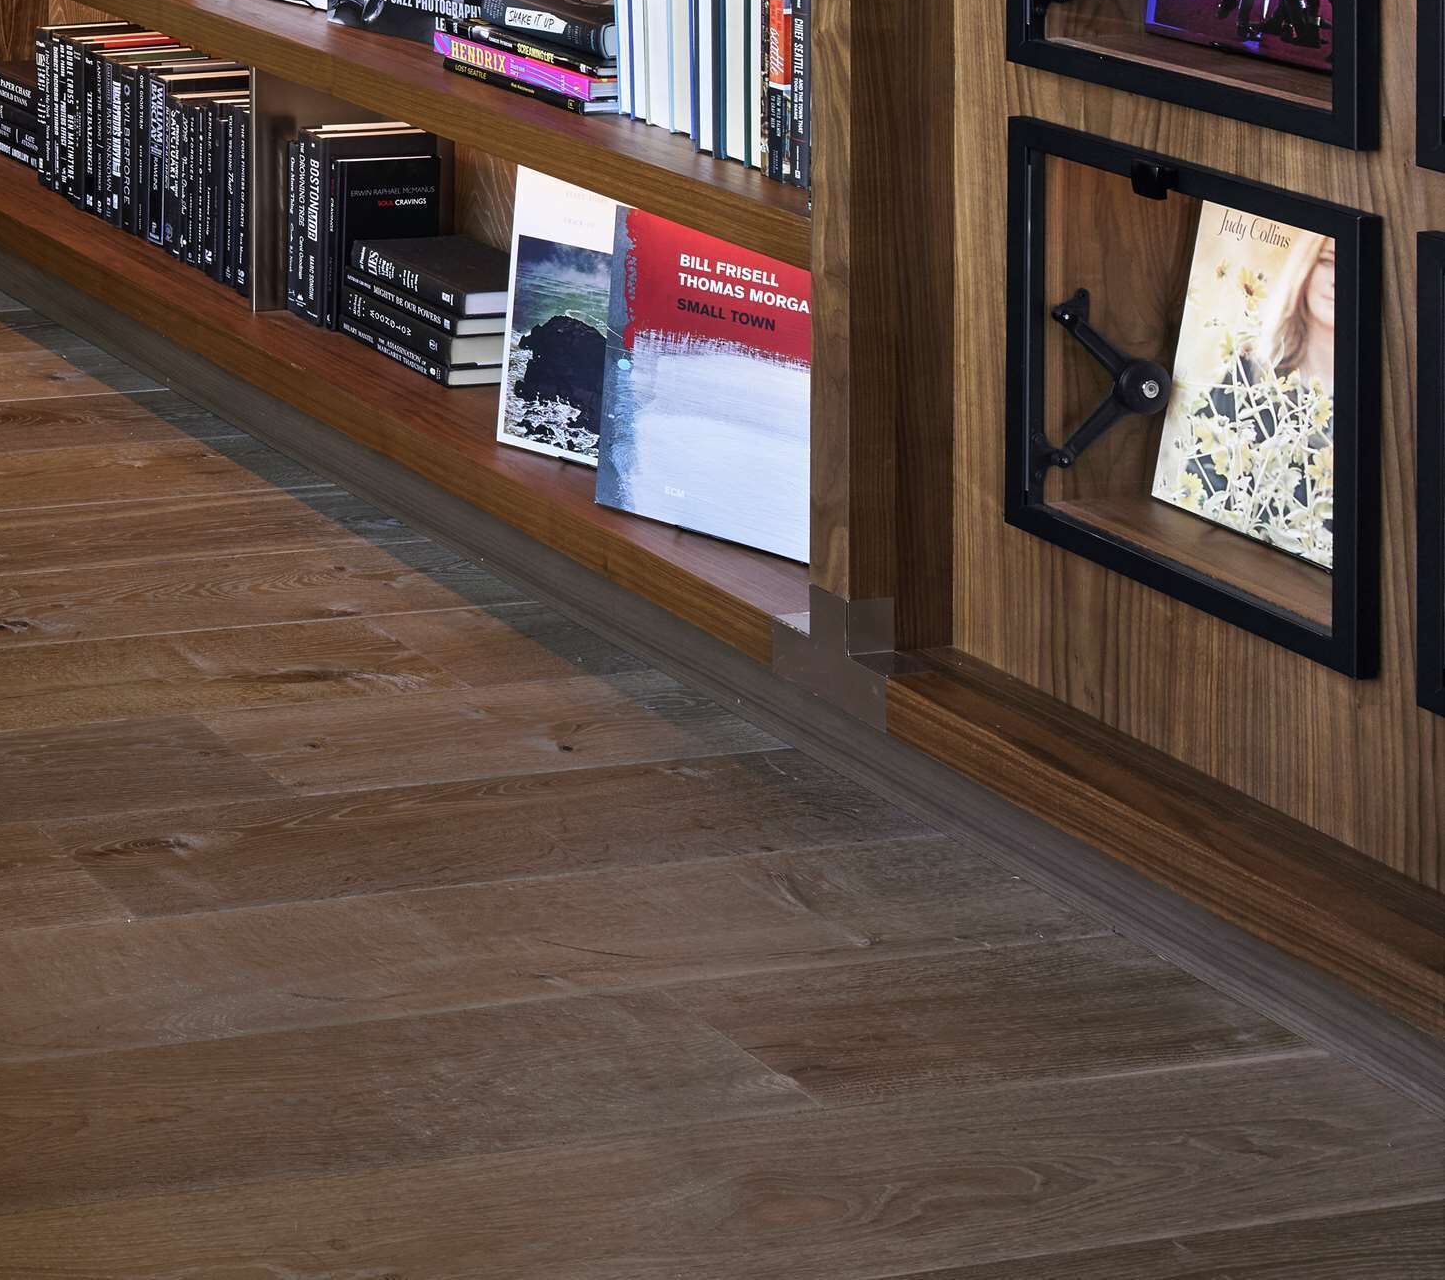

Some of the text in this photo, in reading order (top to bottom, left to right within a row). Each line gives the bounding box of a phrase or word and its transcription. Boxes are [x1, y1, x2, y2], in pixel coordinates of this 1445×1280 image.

[508, 10, 555, 30] SHAKE IT UP
[66, 45, 74, 76] DOUBLE
[451, 40, 507, 74] HENDRIX
[794, 17, 804, 76] CHIEF SEATTLE
[0, 78, 15, 92] PAPER
[15, 84, 32, 99] CHASE
[455, 64, 487, 80] LOST SEATTLE
[310, 158, 320, 211] BOSTON
[350, 189, 373, 198] ERWIN
[373, 188, 401, 196] RAPHAEL
[394, 197, 427, 206] CRAVINGS
[1217, 208, 1291, 250] Judy Collins
[678, 253, 780, 289] BILL FRISELL
[373, 285, 442, 325] MIGHTY BE OUR POWERS
[677, 272, 811, 315] THOMAS MORGA
[676, 297, 776, 333] SMALL TOWN
[377, 343, 428, 375] MARGARET THATCHER
[386, 338, 422, 363] ASSASSINATION
